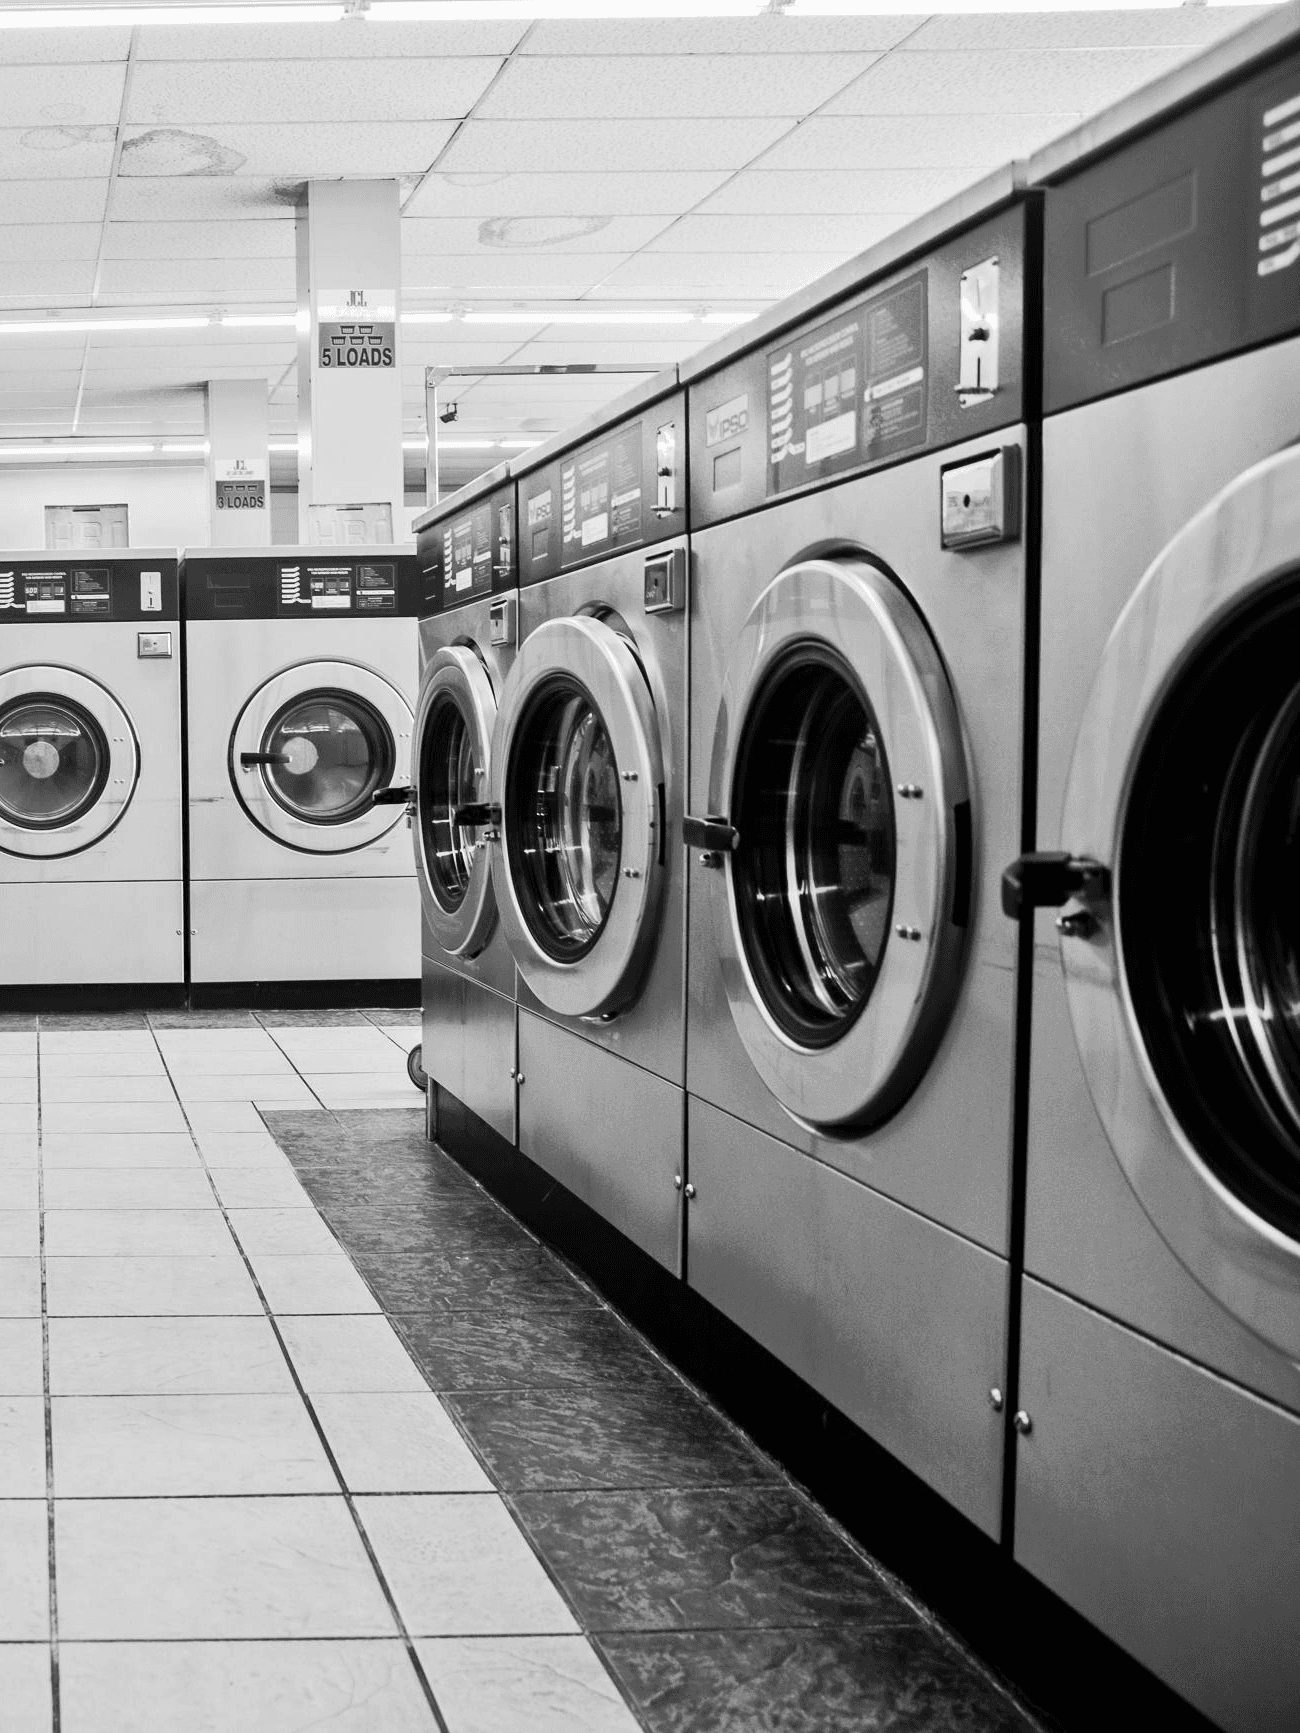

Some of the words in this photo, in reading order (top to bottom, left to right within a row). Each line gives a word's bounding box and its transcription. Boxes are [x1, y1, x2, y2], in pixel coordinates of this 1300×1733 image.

[322, 348, 332, 367] 5
[336, 347, 393, 367] LOADS
[218, 496, 225, 509] 3
[227, 495, 264, 508] LOADS
